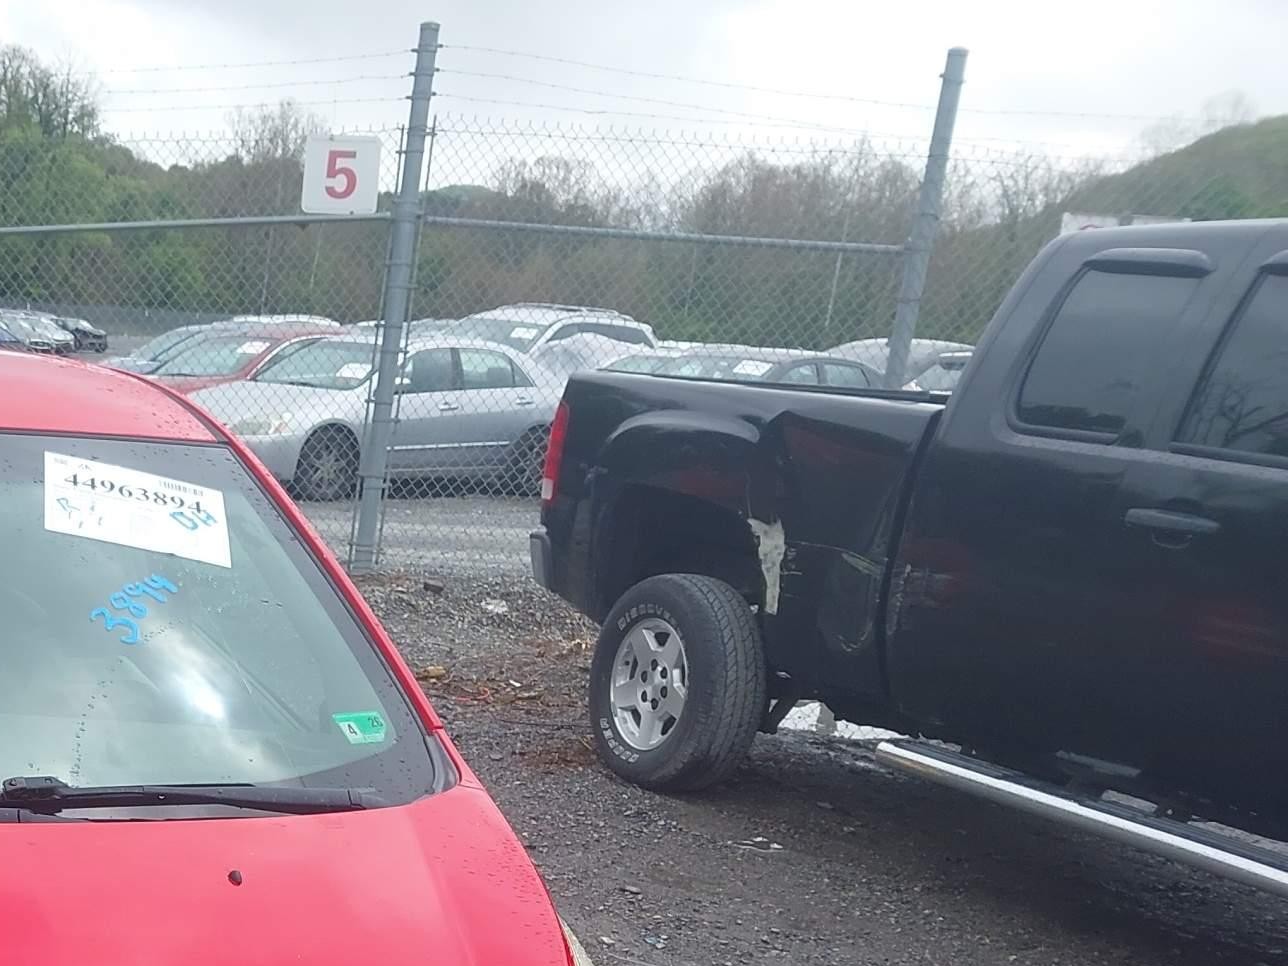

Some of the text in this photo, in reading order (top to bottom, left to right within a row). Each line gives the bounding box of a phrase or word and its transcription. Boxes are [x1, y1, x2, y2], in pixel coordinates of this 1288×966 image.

[325, 150, 357, 199] 5
[63, 472, 207, 513] 44963894
[90, 574, 178, 644] 3894
[347, 723, 358, 736] 4
